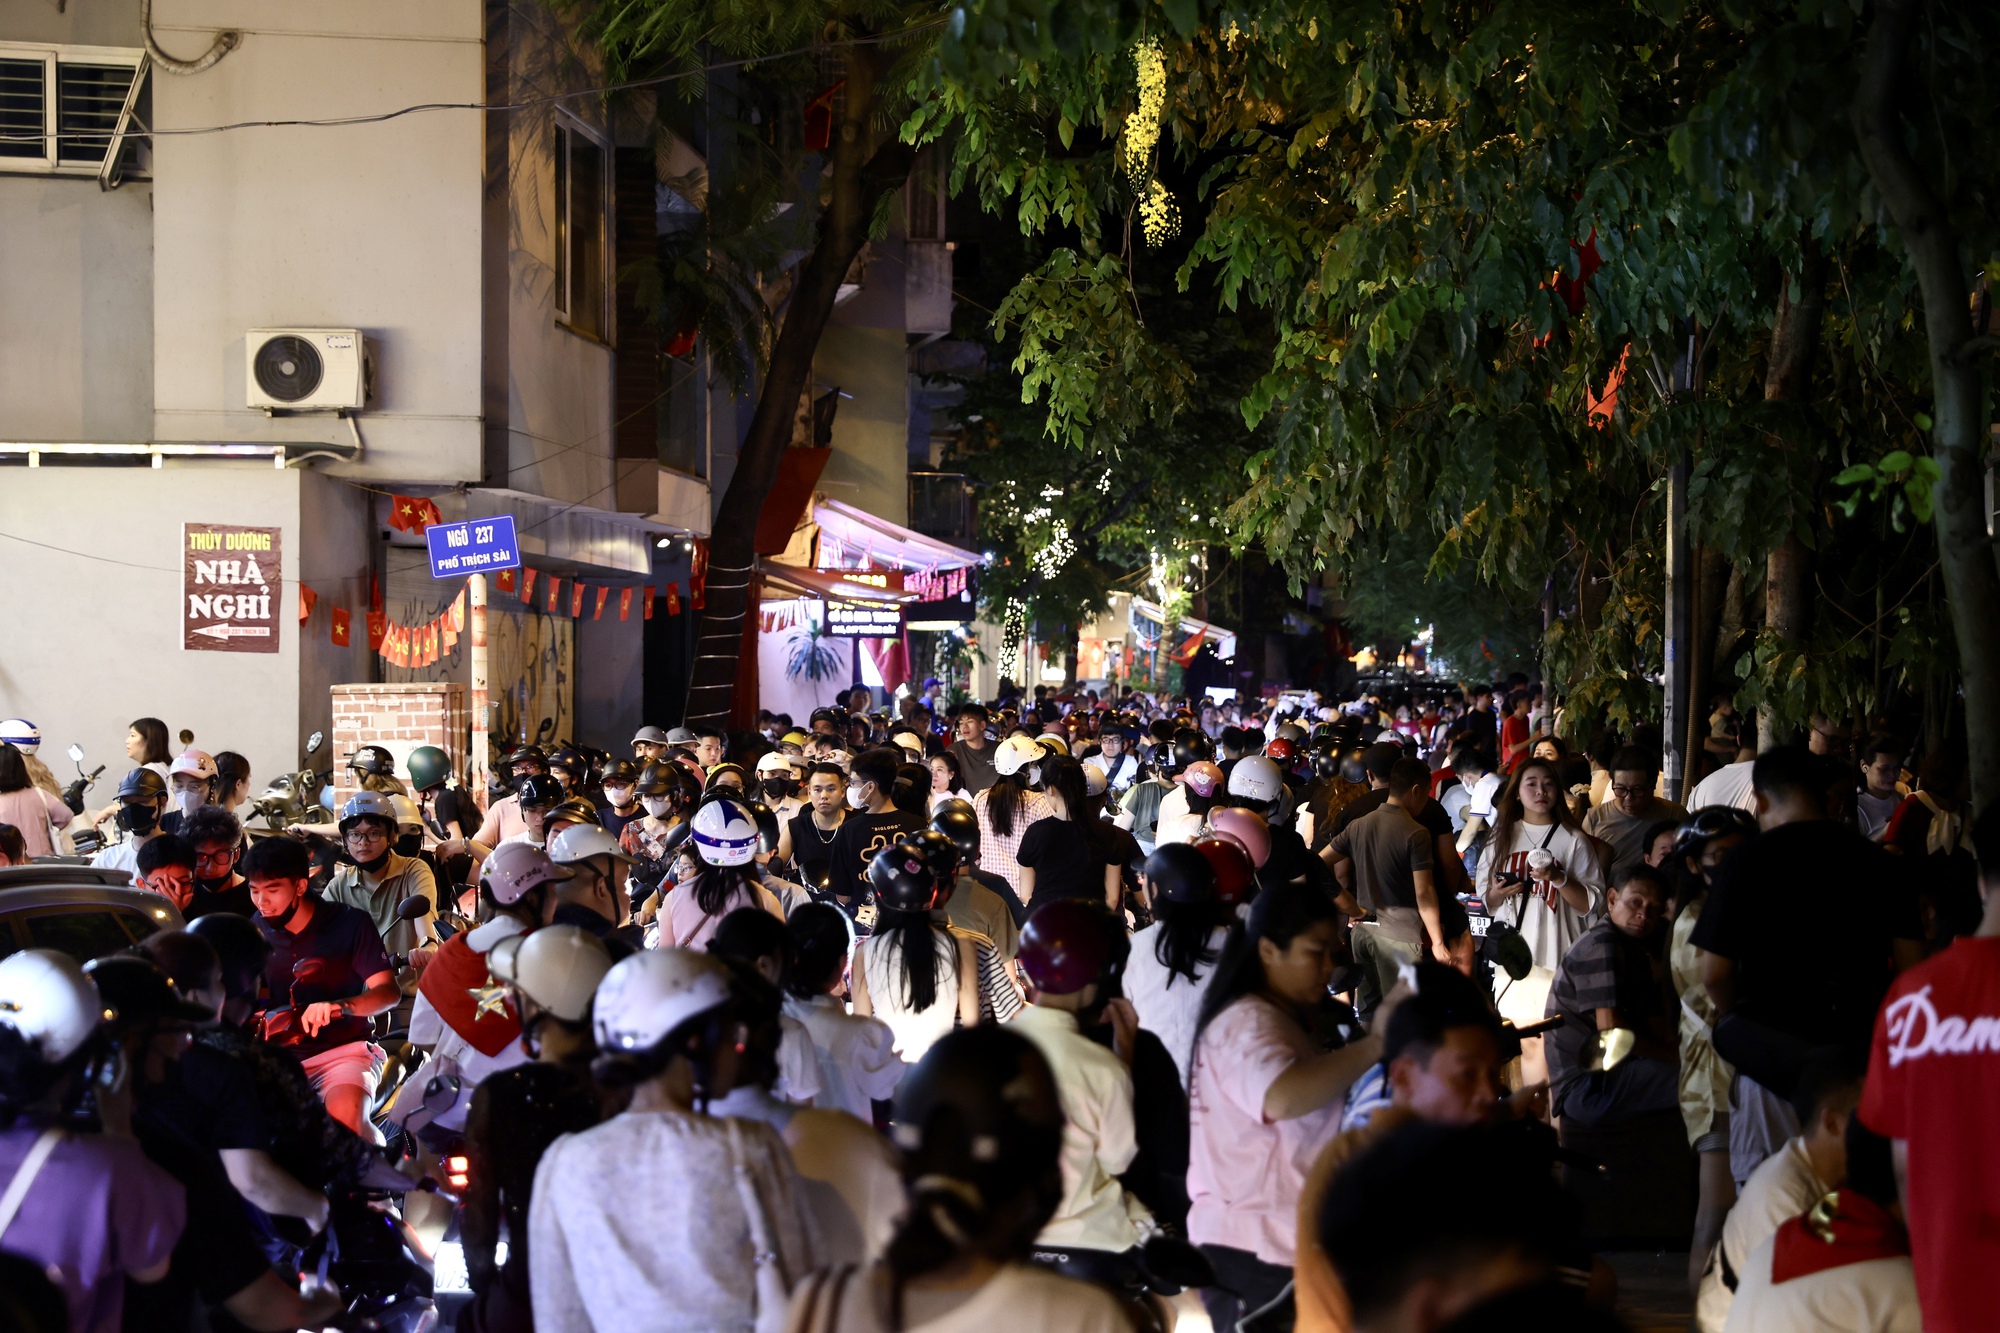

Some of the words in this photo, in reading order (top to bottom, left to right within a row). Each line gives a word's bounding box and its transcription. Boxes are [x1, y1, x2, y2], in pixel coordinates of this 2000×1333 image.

[189, 530, 222, 550] THÙY
[225, 532, 271, 551] DƯƠNG
[446, 526, 469, 547] NGÕ
[475, 525, 493, 544] 237
[194, 553, 265, 584] NHÀ
[438, 554, 459, 570] PHỐ
[460, 552, 490, 566] TRÍCH
[492, 549, 510, 562] SÀI
[188, 585, 270, 619] NGHỈ
[514, 866, 543, 887] prada
